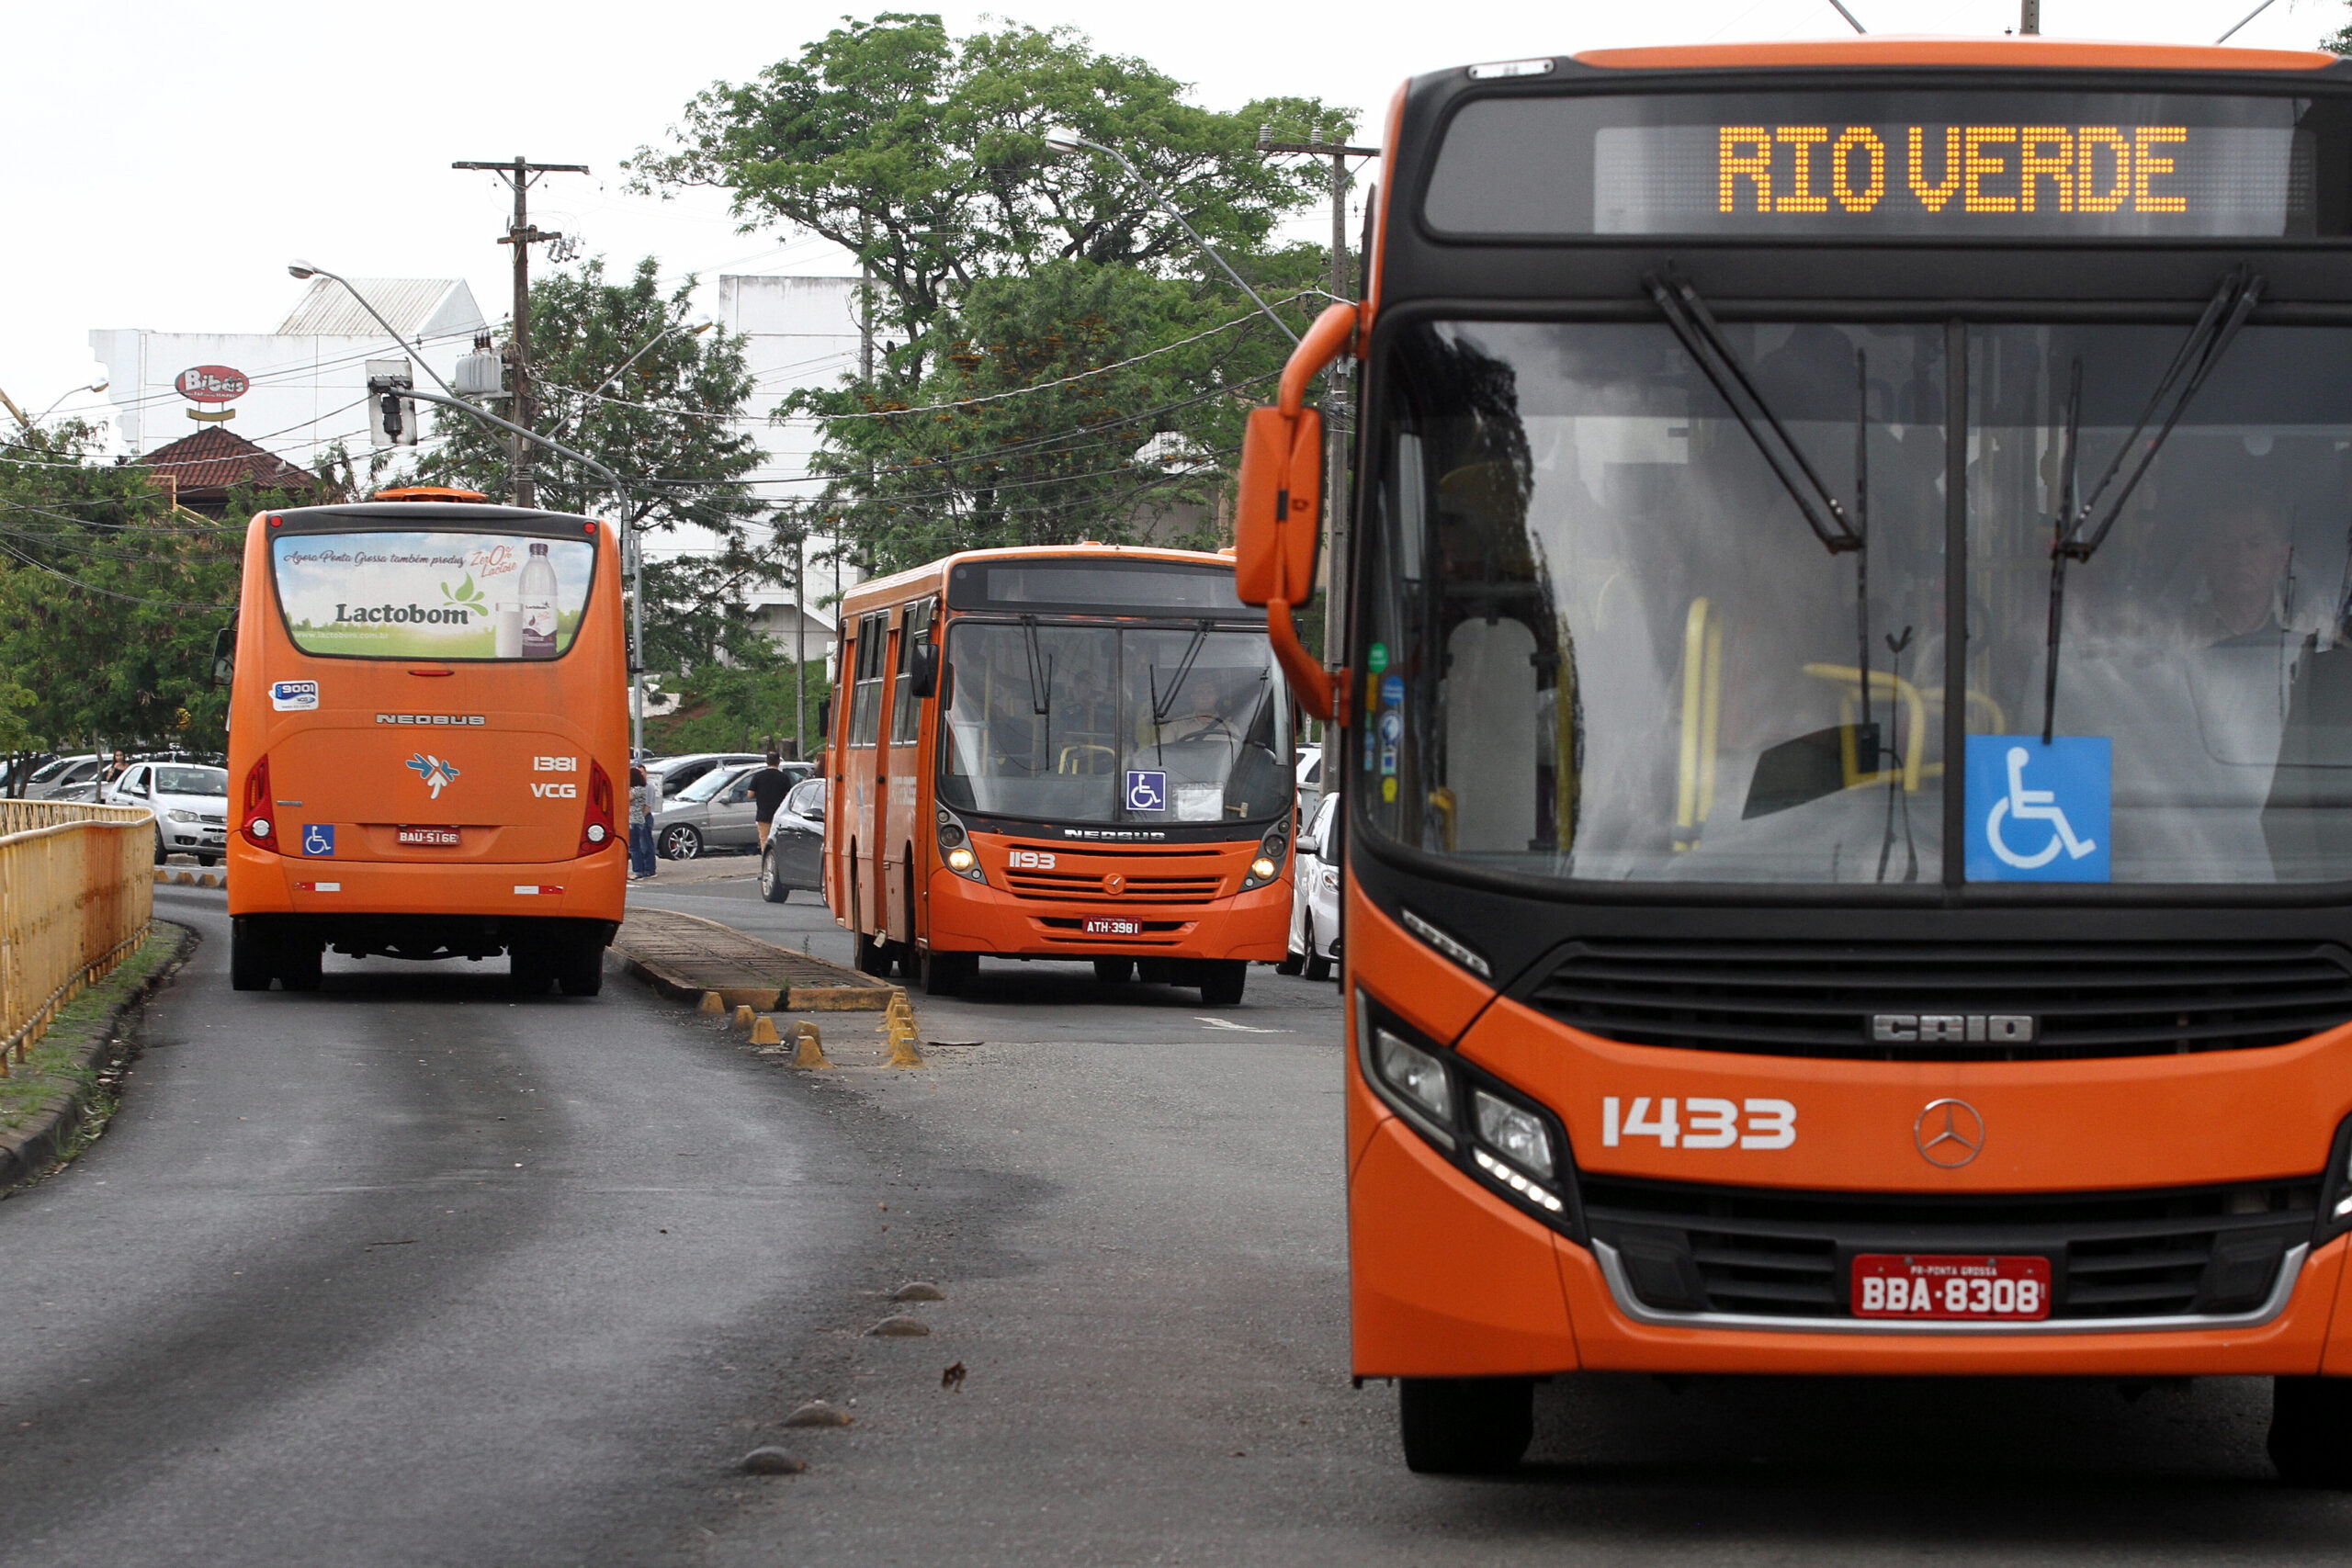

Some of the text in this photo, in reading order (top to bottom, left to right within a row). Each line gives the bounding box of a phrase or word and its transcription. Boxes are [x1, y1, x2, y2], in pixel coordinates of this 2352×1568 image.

[1720, 127, 2187, 212] RIO VERDE
[284, 550, 464, 568] Agora Ponta Grossa também produz
[335, 604, 469, 625] Lactobom
[282, 683, 313, 694] 9001
[376, 714, 486, 726] NEOBUS
[534, 756, 577, 772] 1381
[530, 783, 577, 798] VCG
[1064, 829, 1166, 840] NEOBUS
[1009, 851, 1056, 869] 1193
[1872, 1014, 2034, 1042] CAIO
[1601, 1096, 1797, 1150] 1433
[1961, 1266, 1997, 1276] GROSSA
